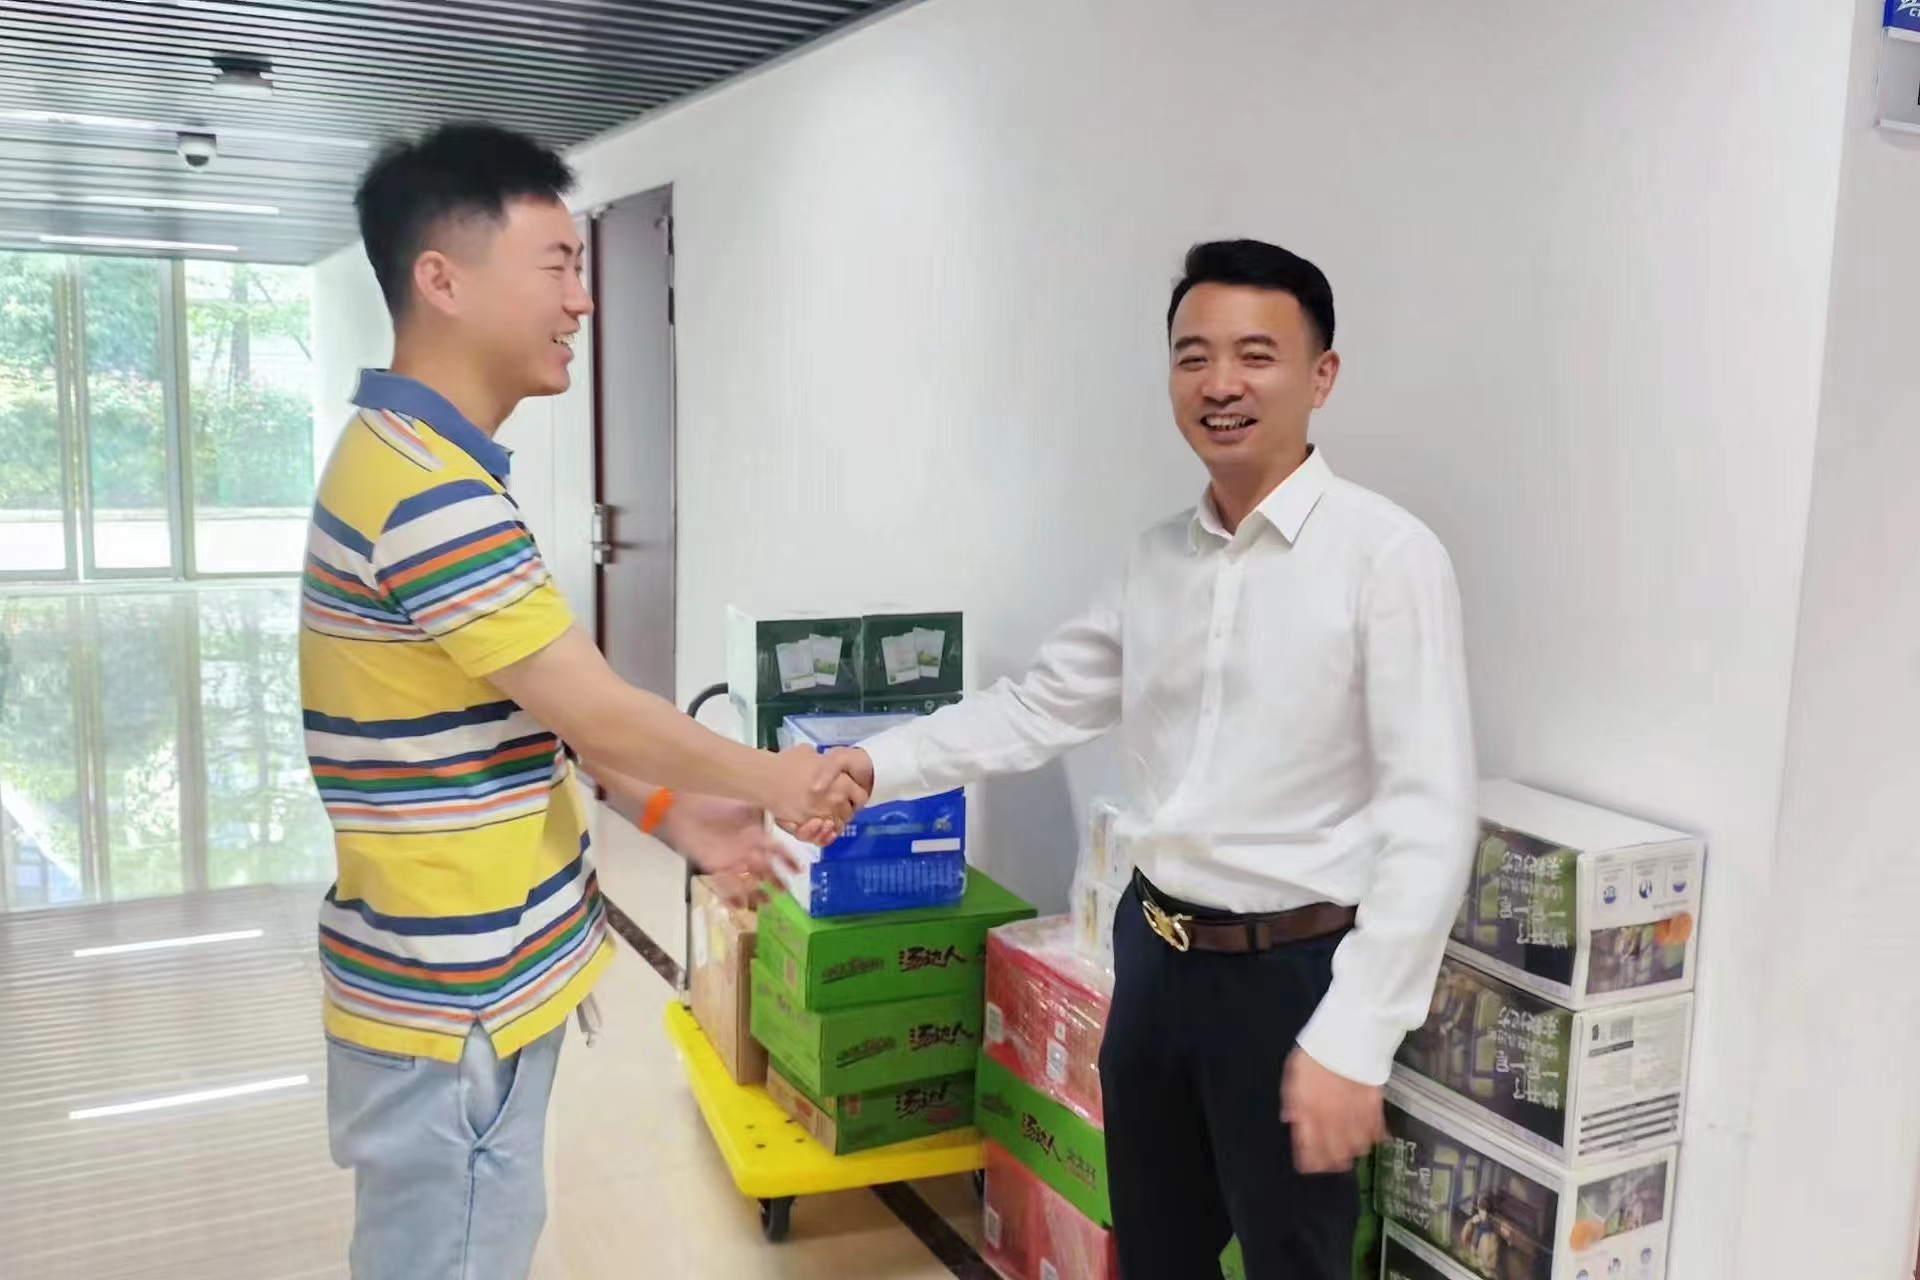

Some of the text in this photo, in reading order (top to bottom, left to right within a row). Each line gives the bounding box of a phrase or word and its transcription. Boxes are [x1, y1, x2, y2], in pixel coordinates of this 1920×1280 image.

[898, 944, 968, 972] 汤达人
[909, 1020, 976, 1051] 汤达人
[1021, 1111, 1063, 1167] 汤达人
